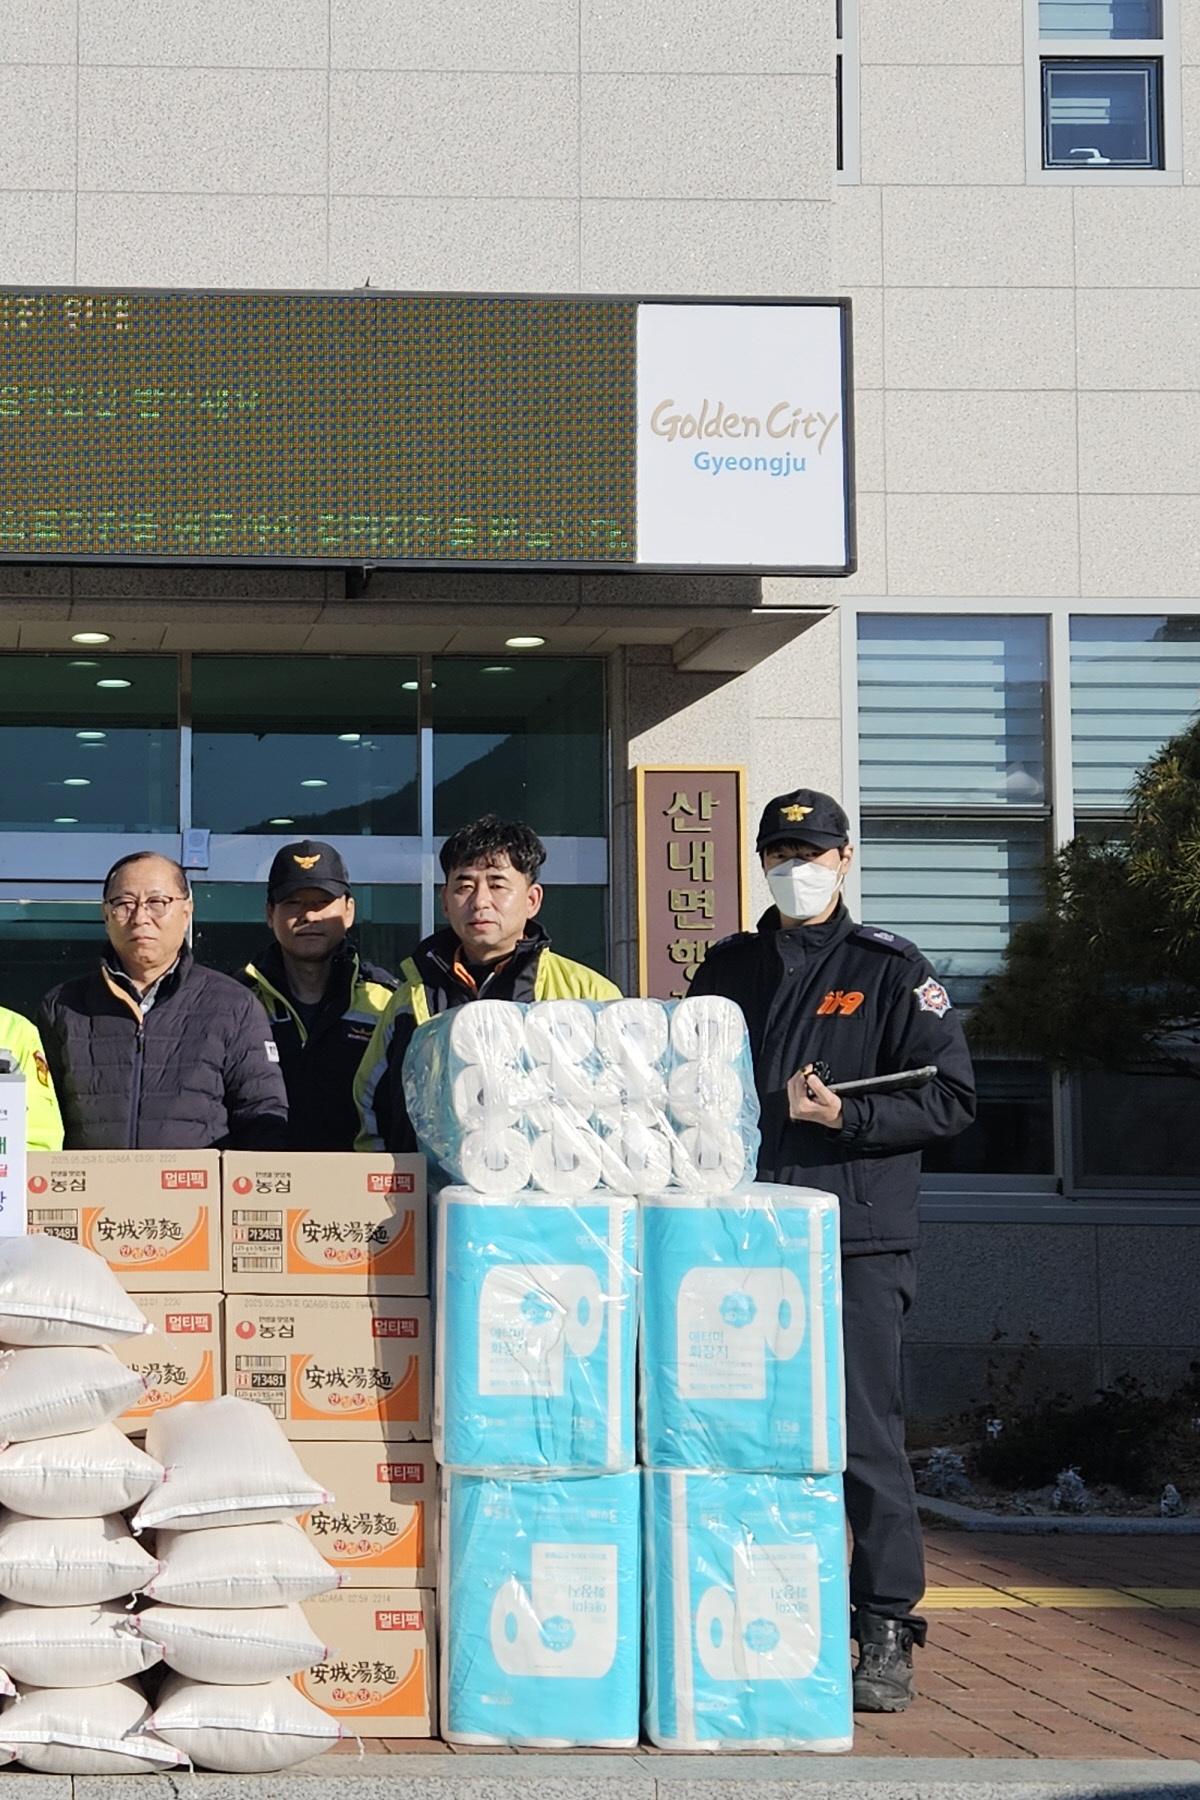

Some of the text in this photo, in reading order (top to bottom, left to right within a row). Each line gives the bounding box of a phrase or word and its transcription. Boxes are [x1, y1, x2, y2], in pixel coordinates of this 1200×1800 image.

[650, 398, 839, 455] Golden City
[694, 451, 806, 476] Gyeongju
[50, 1178, 86, 1193] 농심
[164, 1173, 205, 1187] 멀티팩
[255, 1179, 291, 1194] 농심
[370, 1175, 411, 1191] 멀티팩
[97, 1217, 182, 1241] 安城湯麵
[249, 1229, 281, 1241] 가3481
[302, 1219, 389, 1244] 安城湯麵
[168, 1315, 209, 1331] 멀티팩
[374, 1320, 416, 1336] 멀티팩
[259, 1324, 295, 1339] 농심
[689, 1331, 724, 1344] 애터미
[689, 1345, 729, 1359] 화장지
[252, 1374, 285, 1386] 가3481
[305, 1365, 392, 1390] 安城湯麵
[380, 1465, 420, 1481] 멀티팩
[311, 1510, 398, 1536] 安城湯麵
[568, 1584, 606, 1599] 화장지
[770, 1585, 808, 1599] 화장지
[572, 1600, 607, 1613] 애터미
[379, 1612, 419, 1629] 멀티팩
